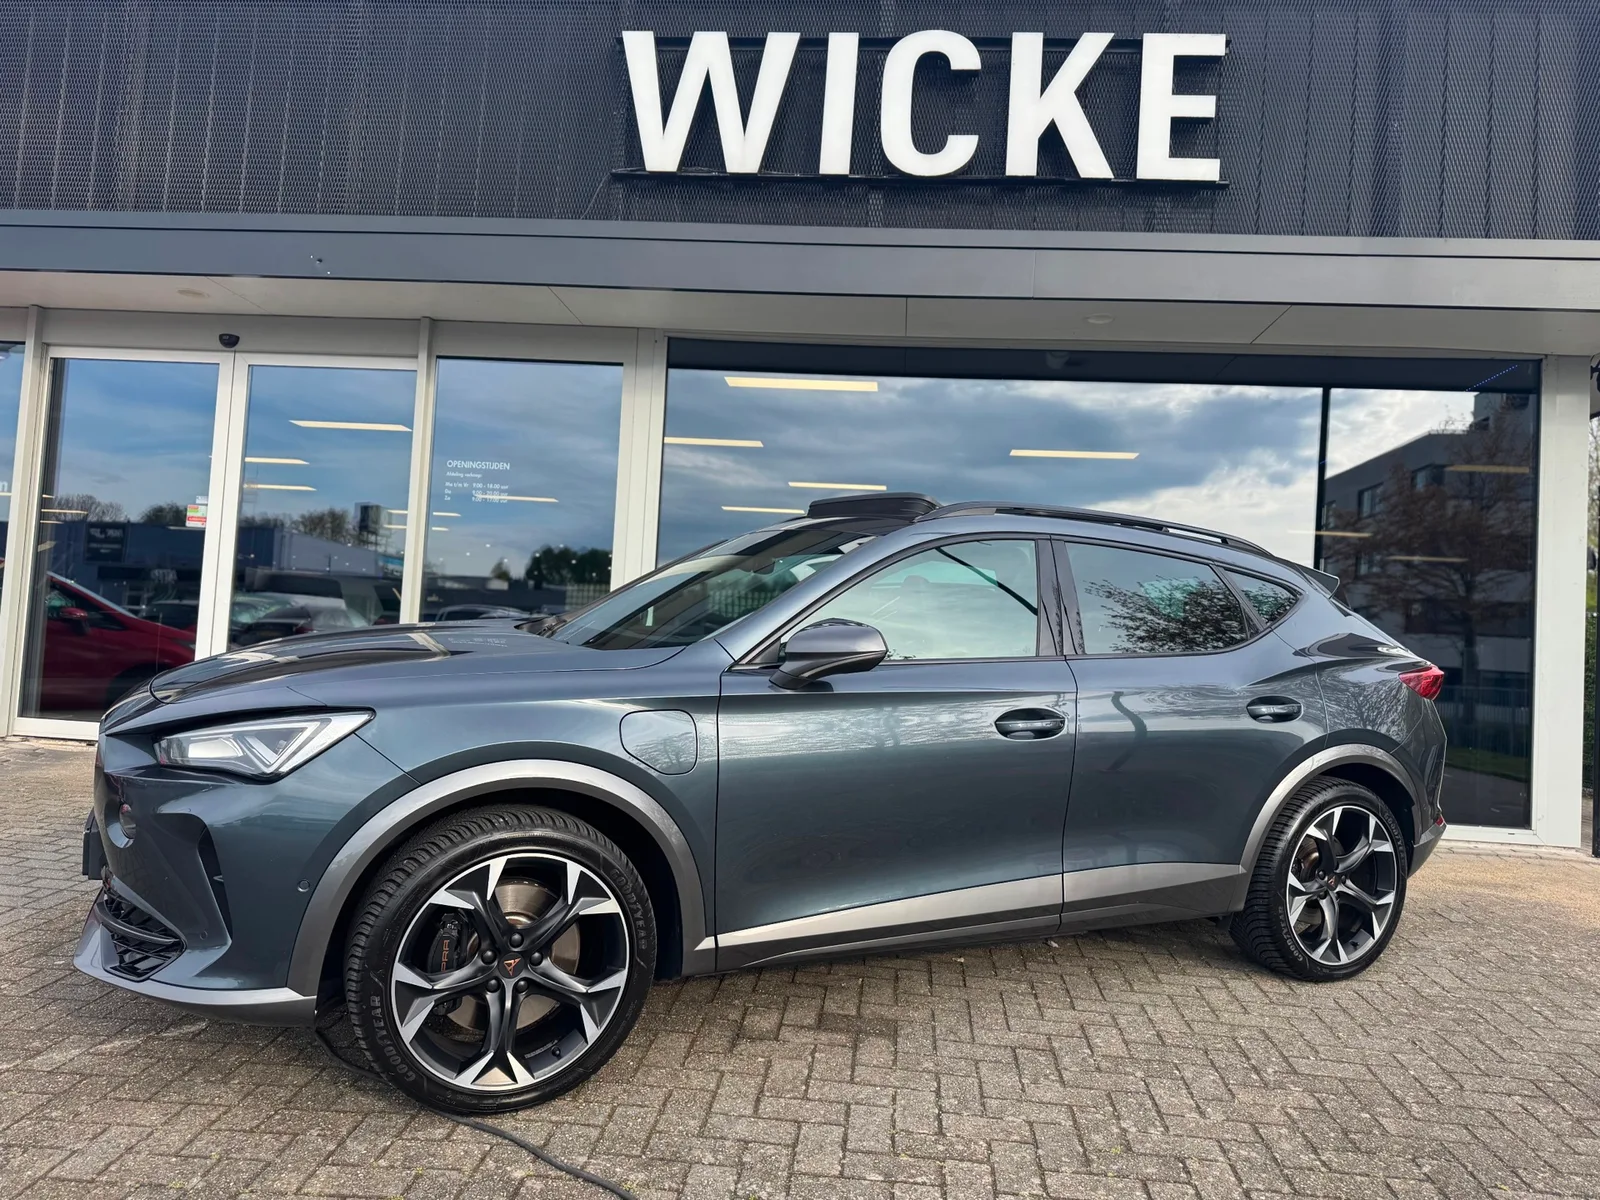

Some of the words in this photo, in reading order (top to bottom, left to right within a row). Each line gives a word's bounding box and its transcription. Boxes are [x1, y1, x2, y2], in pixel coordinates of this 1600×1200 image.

[622, 29, 1227, 181] WICKE
[446, 460, 511, 470] OPENINGSTIJDEN
[370, 995, 416, 1082] GOODYEAR
